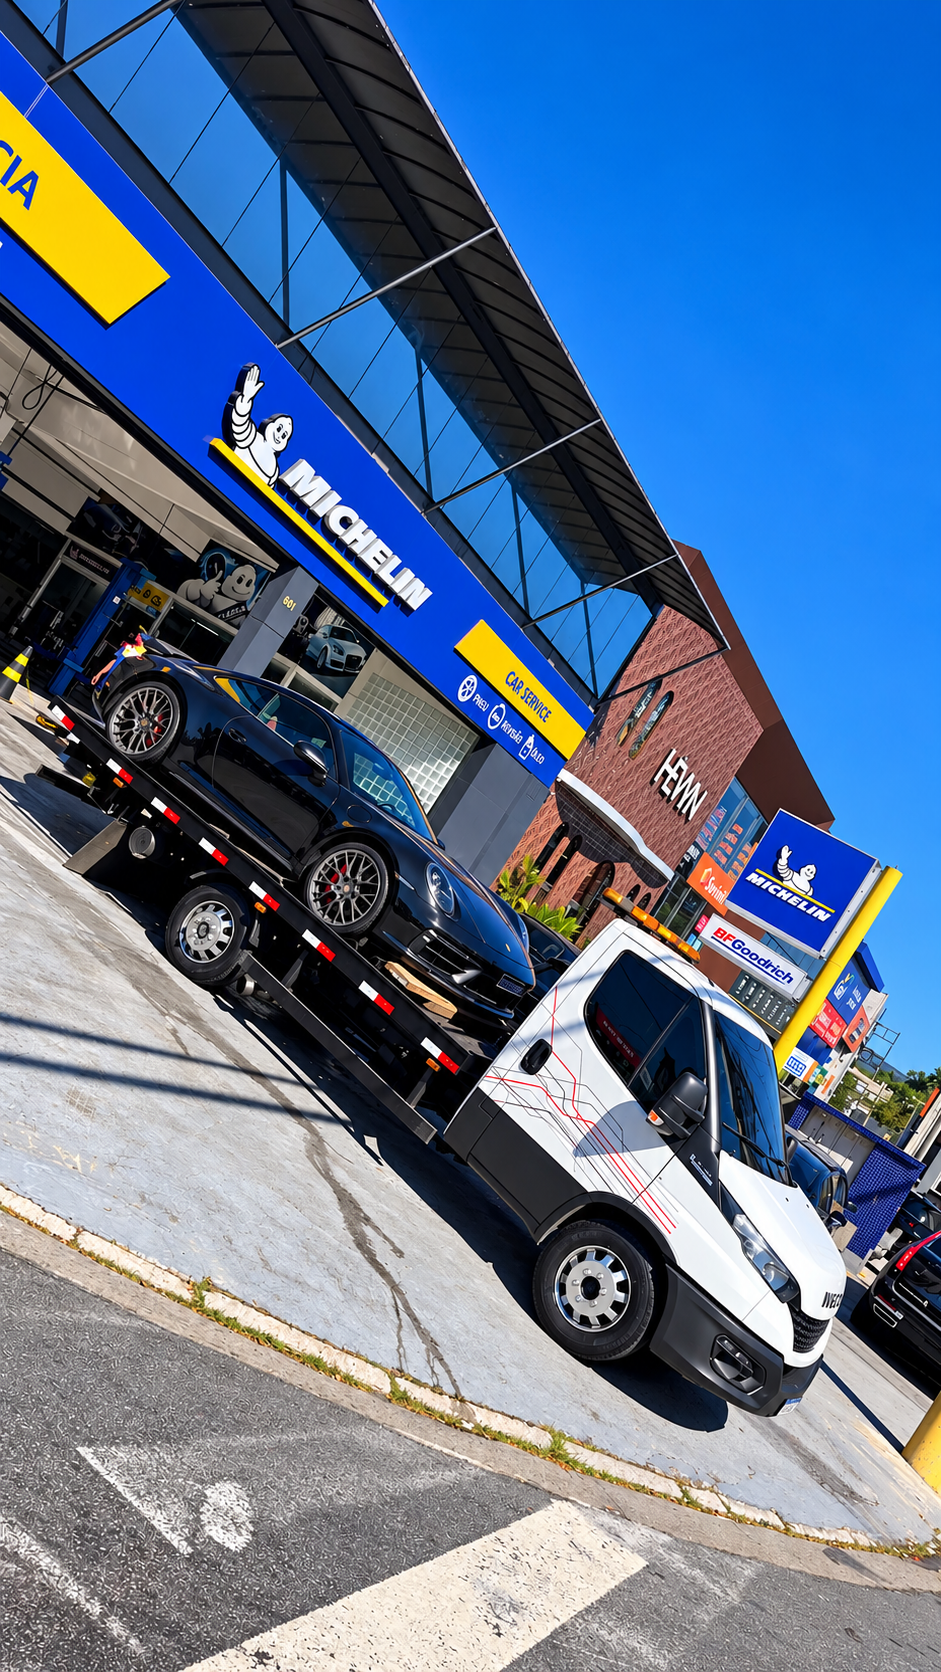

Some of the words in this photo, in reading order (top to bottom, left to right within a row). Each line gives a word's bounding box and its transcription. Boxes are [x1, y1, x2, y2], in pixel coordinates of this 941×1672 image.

[279, 458, 433, 611] MICHELIN
[282, 595, 297, 611] 601
[505, 671, 524, 695] CAR
[521, 687, 552, 723] SERVICE
[745, 872, 832, 922] MICHELIN
[712, 926, 794, 985] BFGoodrich
